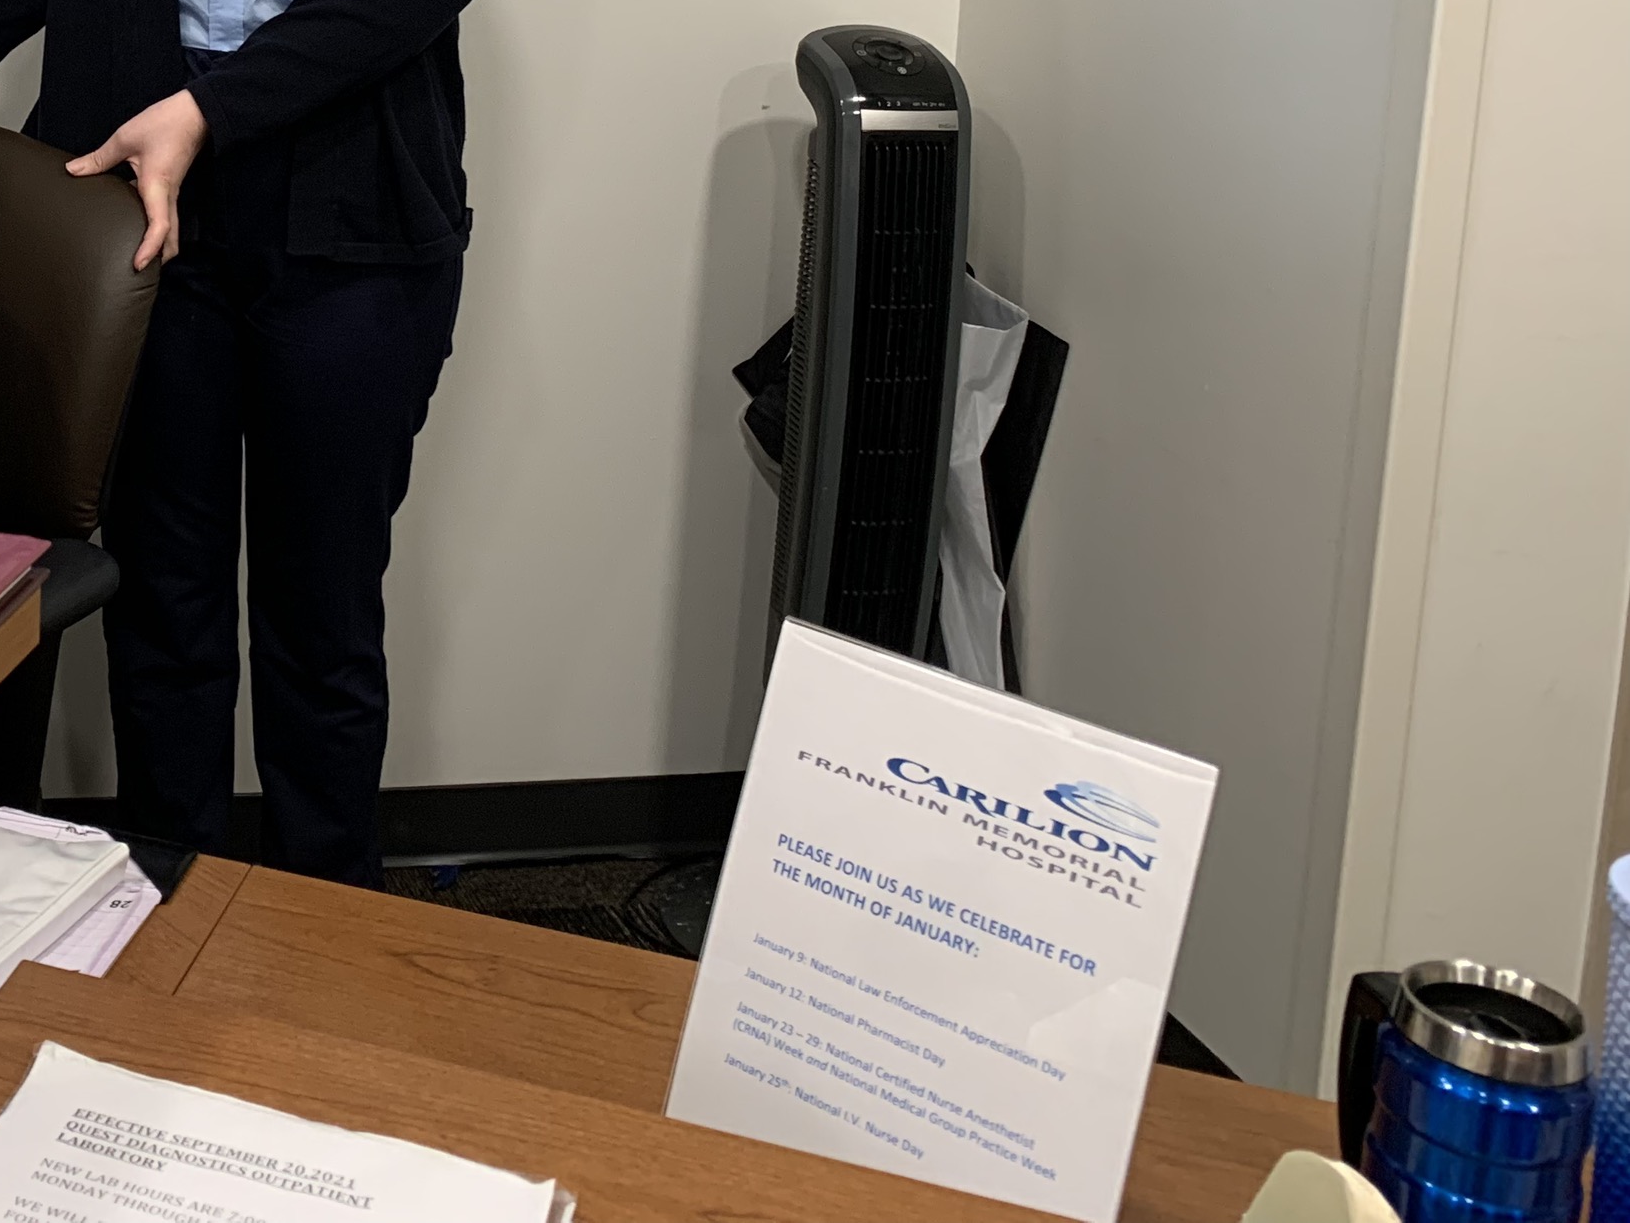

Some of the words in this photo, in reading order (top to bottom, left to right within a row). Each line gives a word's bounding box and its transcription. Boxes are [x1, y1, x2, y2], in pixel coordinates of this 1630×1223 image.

[797, 750, 949, 816] FRANKLIN
[962, 812, 1146, 892] MEMORIAL
[886, 757, 1158, 872] CARILION
[772, 858, 802, 883] THE
[804, 872, 867, 911] MONTH
[870, 900, 893, 919] OF
[894, 910, 980, 958] JANUARY:
[777, 833, 834, 868] PLEASE
[835, 857, 873, 884] JOIN
[876, 873, 899, 894] US
[900, 884, 924, 904] AS
[928, 893, 957, 918] WE
[959, 908, 1056, 960] CELEBRATE
[1058, 948, 1097, 977] FOR
[976, 835, 1142, 909] HOSPITAL
[744, 967, 787, 995] January
[788, 986, 806, 1003] 12:
[808, 995, 856, 1026] National
[857, 1017, 921, 1057] Pharmacist
[922, 1047, 946, 1069] Day
[753, 932, 795, 961] January
[796, 951, 807, 965] 9:
[809, 957, 858, 988] National
[858, 979, 882, 998] Law
[883, 990, 959, 1033] Enforcement
[960, 1025, 1039, 1069] Appreciation
[1041, 1060, 1067, 1082] Day
[724, 1052, 767, 1082] January
[794, 1086, 842, 1118] National
[865, 1121, 900, 1147] Nurse
[901, 1139, 925, 1160] Day
[732, 1018, 771, 1047] (CRNA)
[773, 1036, 804, 1061] Week
[805, 1055, 829, 1072] and
[829, 1064, 878, 1096] National
[880, 1088, 927, 1119] Medical
[928, 1112, 967, 1139] Group
[969, 1130, 1019, 1163] Practice
[1021, 1155, 1057, 1181] Week
[737, 1001, 779, 1030] January
[780, 1021, 795, 1037] 23
[805, 1033, 823, 1051] 29:
[825, 1042, 874, 1074] National
[875, 1065, 926, 1098] Certified
[927, 1090, 964, 1116] Nurse
[965, 1109, 1036, 1151] Anesthetist
[39, 1157, 82, 1176] NEW
[84, 1170, 120, 1188] LAB
[122, 1181, 185, 1207] HOURS
[186, 1201, 225, 1217] ARE
[56, 1131, 168, 1172] LABORTORY
[65, 1120, 124, 1147] QUEST
[126, 1137, 246, 1177] DIAGNOSTICS
[251, 1169, 375, 1210] OUTPATIENT
[72, 1108, 169, 1142] EFFECTIVE
[170, 1133, 279, 1171] SEPTEMBER
[14, 1195, 44, 1213] WE
[30, 1170, 108, 1201] MONDAY
[112, 1192, 200, 1223] THROUGH
